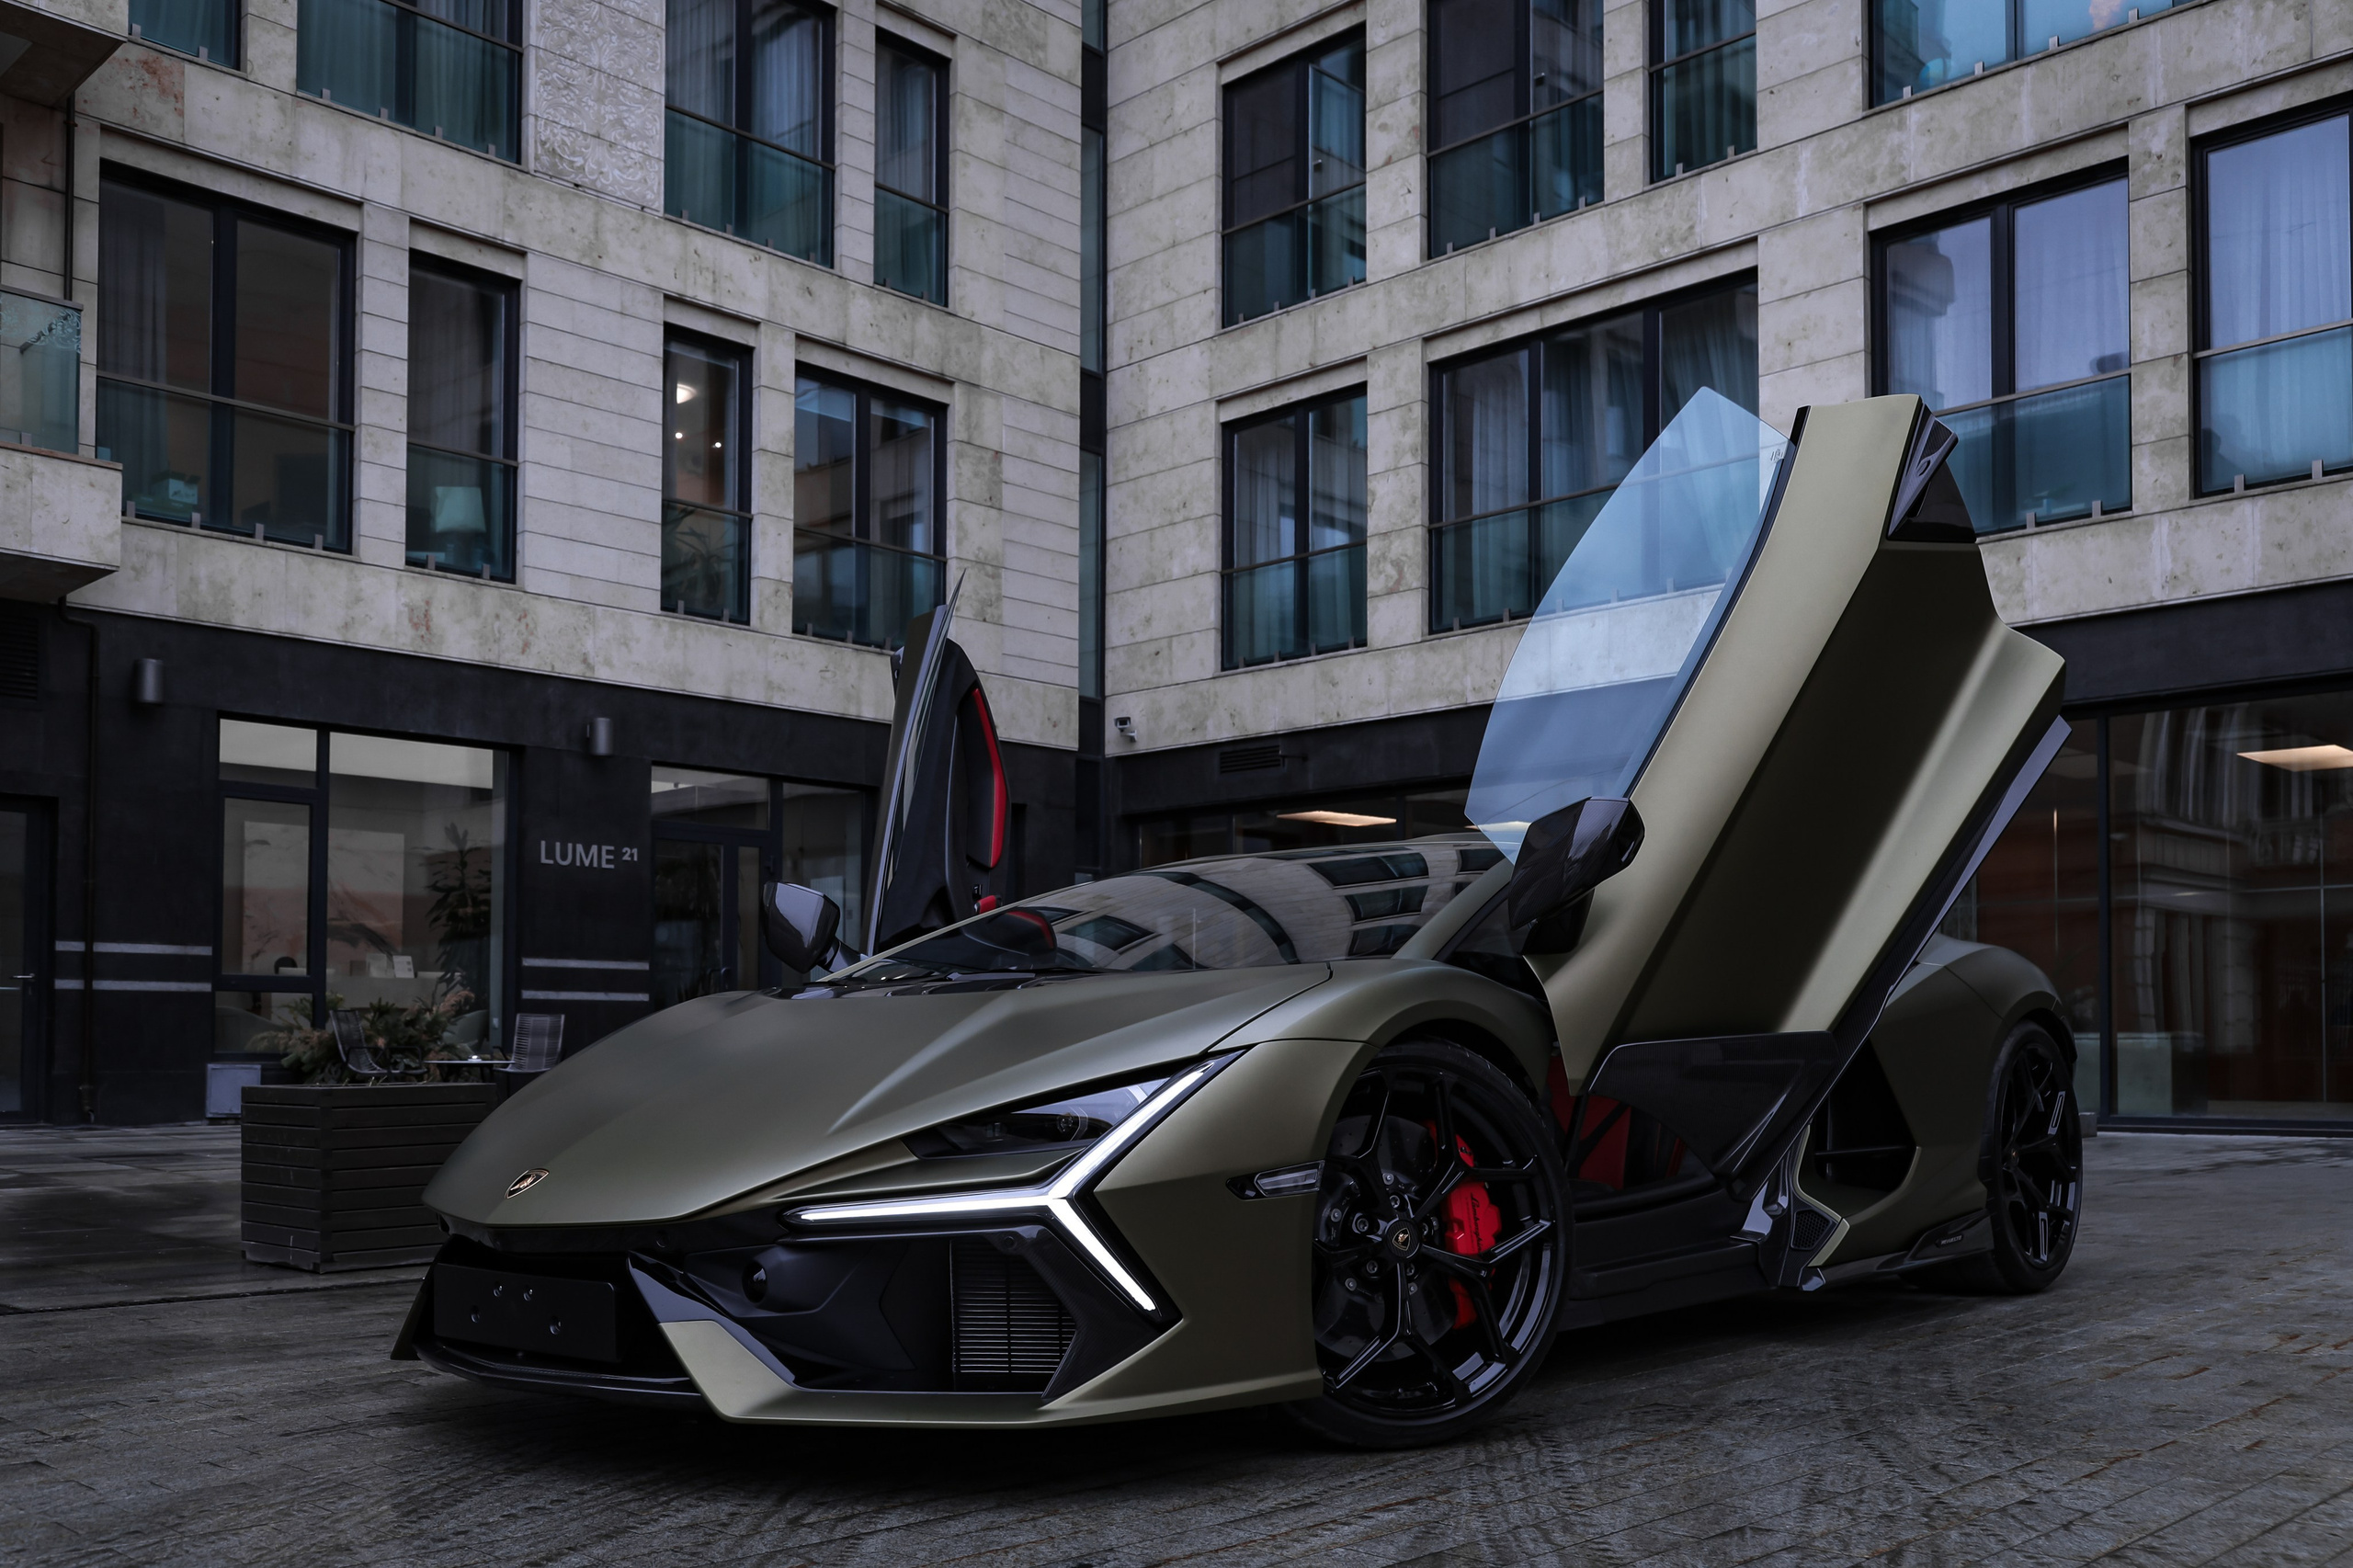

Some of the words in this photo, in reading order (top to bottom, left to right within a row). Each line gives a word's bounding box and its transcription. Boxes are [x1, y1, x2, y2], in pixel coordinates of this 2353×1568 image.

[540, 840, 615, 869] LUME
[621, 846, 638, 861] 21
[1471, 1192, 1482, 1253] Lamborghin
